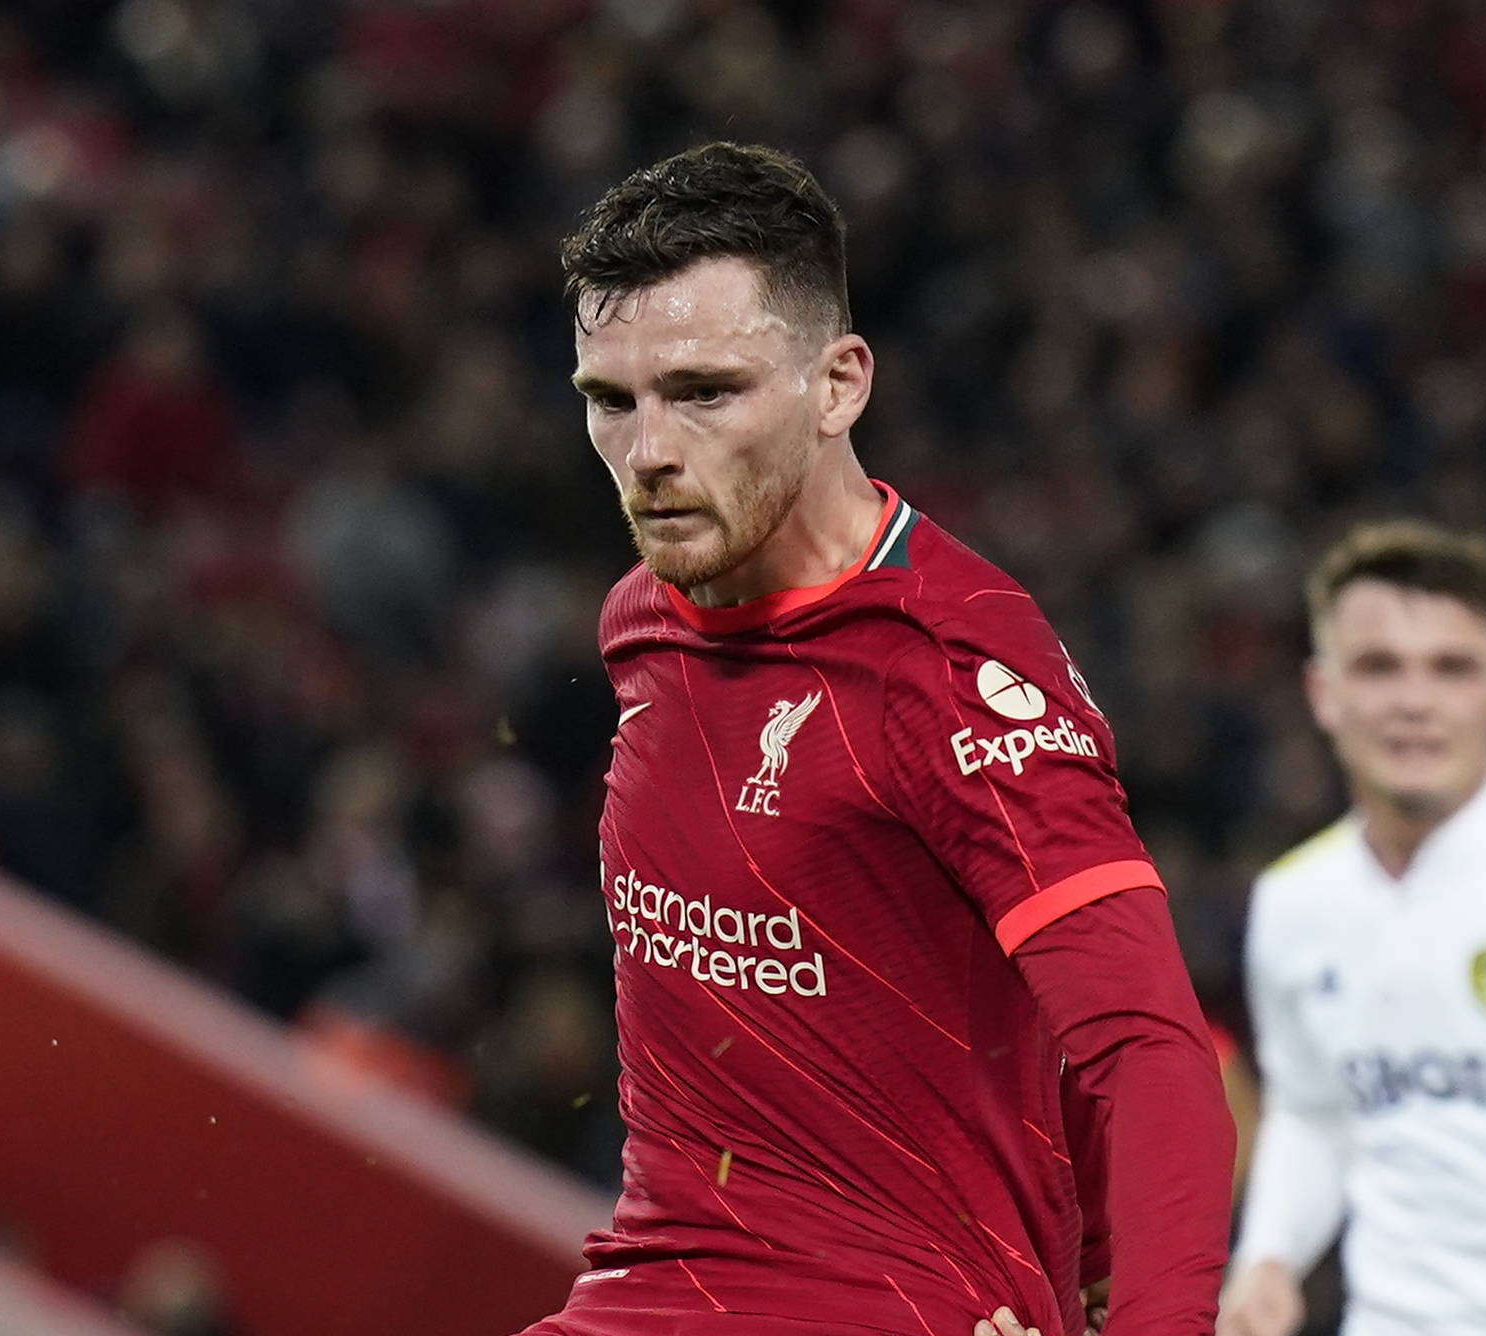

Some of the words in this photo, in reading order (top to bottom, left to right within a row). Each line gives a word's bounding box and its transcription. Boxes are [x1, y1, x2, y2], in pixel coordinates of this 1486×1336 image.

[950, 716, 1099, 776] Expedia
[614, 869, 802, 949] standard
[616, 915, 827, 997] chartered
